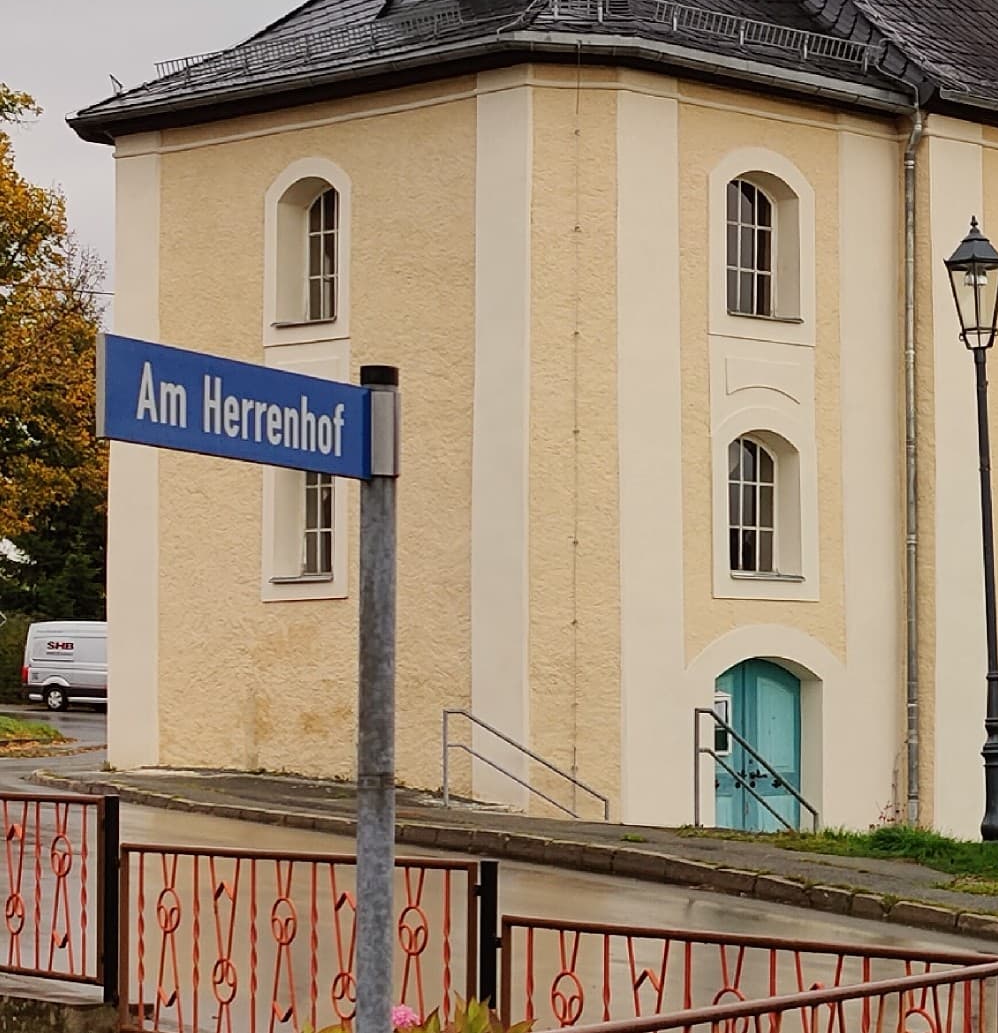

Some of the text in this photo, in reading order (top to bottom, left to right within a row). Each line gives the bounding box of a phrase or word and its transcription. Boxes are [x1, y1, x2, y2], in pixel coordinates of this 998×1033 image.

[136, 361, 345, 457] Am Herrenhof
[47, 641, 74, 650] SHB
